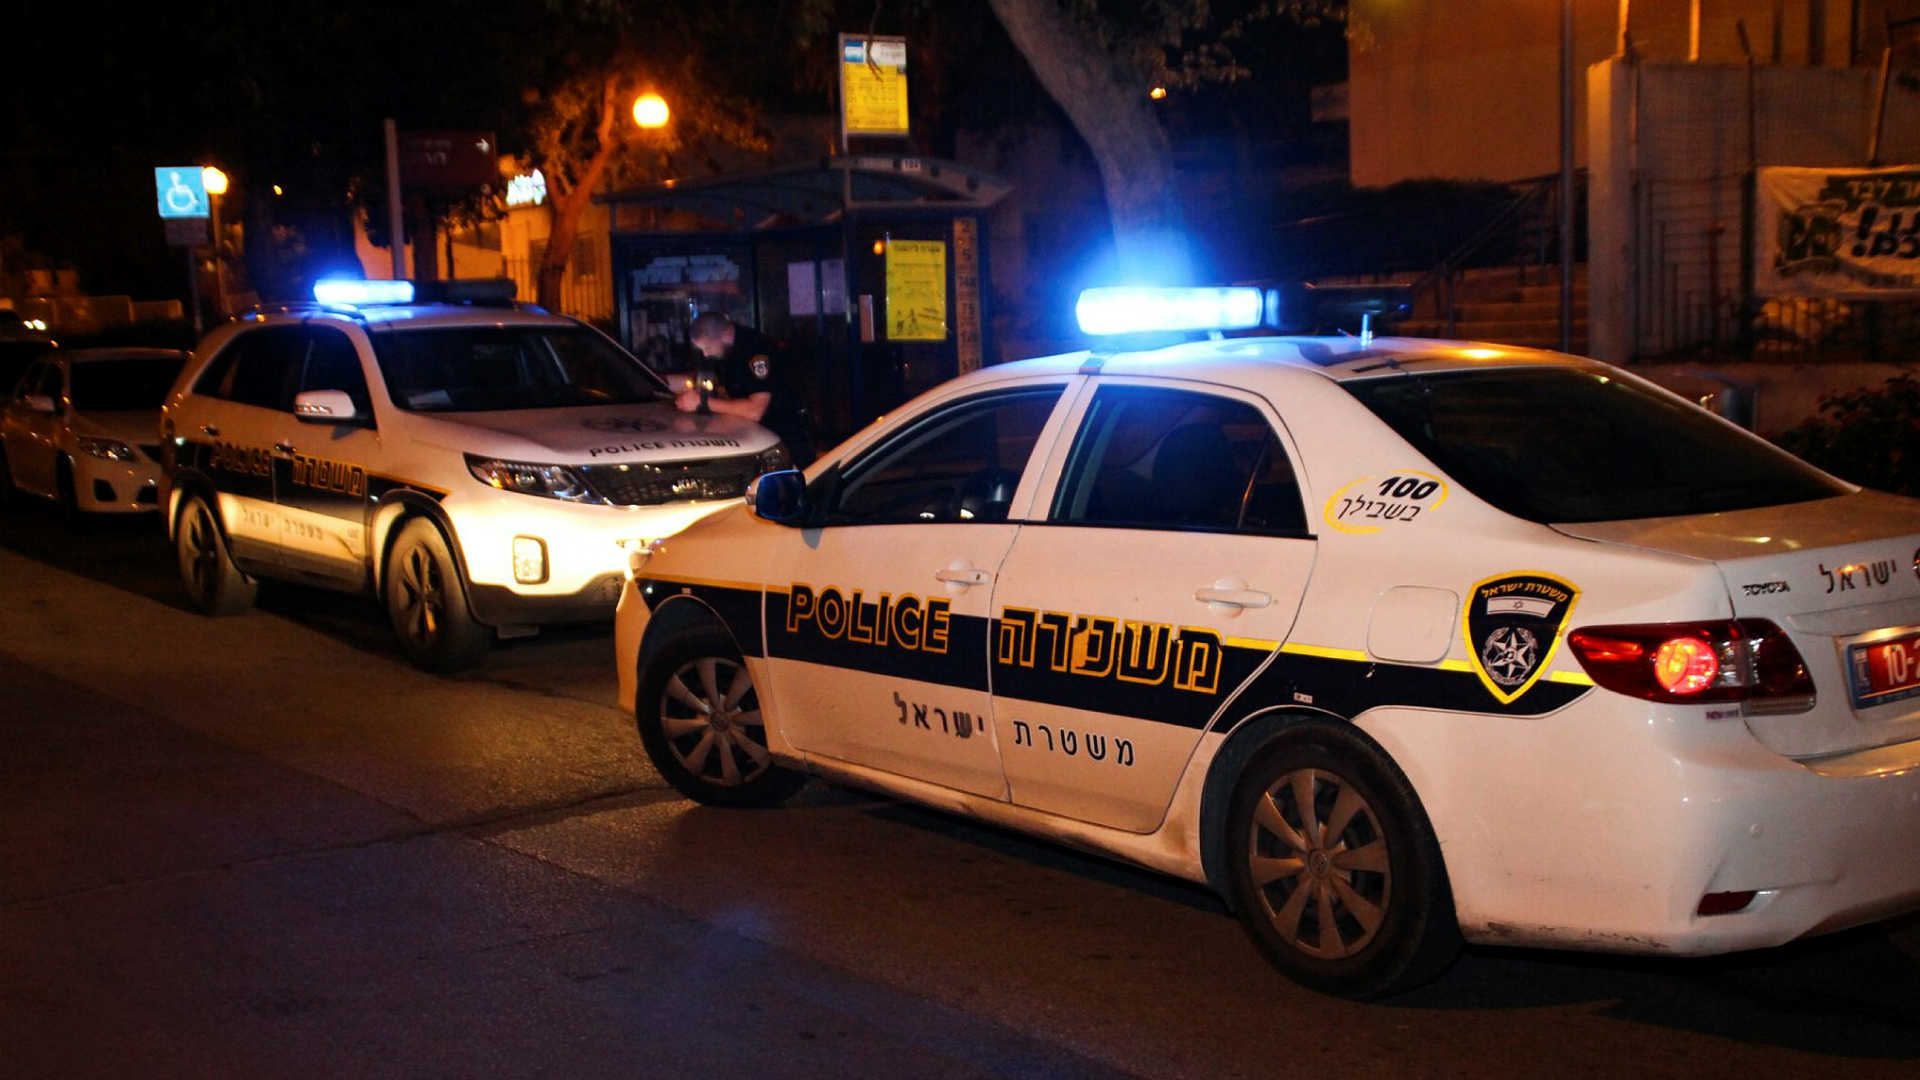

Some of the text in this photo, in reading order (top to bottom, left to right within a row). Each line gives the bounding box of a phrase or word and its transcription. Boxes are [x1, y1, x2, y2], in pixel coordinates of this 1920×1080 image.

[589, 438, 740, 457] POLICE משטרה
[292, 456, 364, 497] משטרה
[1379, 476, 1440, 501] 100
[1338, 494, 1421, 522] בשבילך
[1818, 559, 1897, 594] ישראל
[1480, 582, 1569, 603] משטרת ישראל
[786, 582, 952, 654] POLICE
[893, 691, 1135, 767] משטרת ישראל
